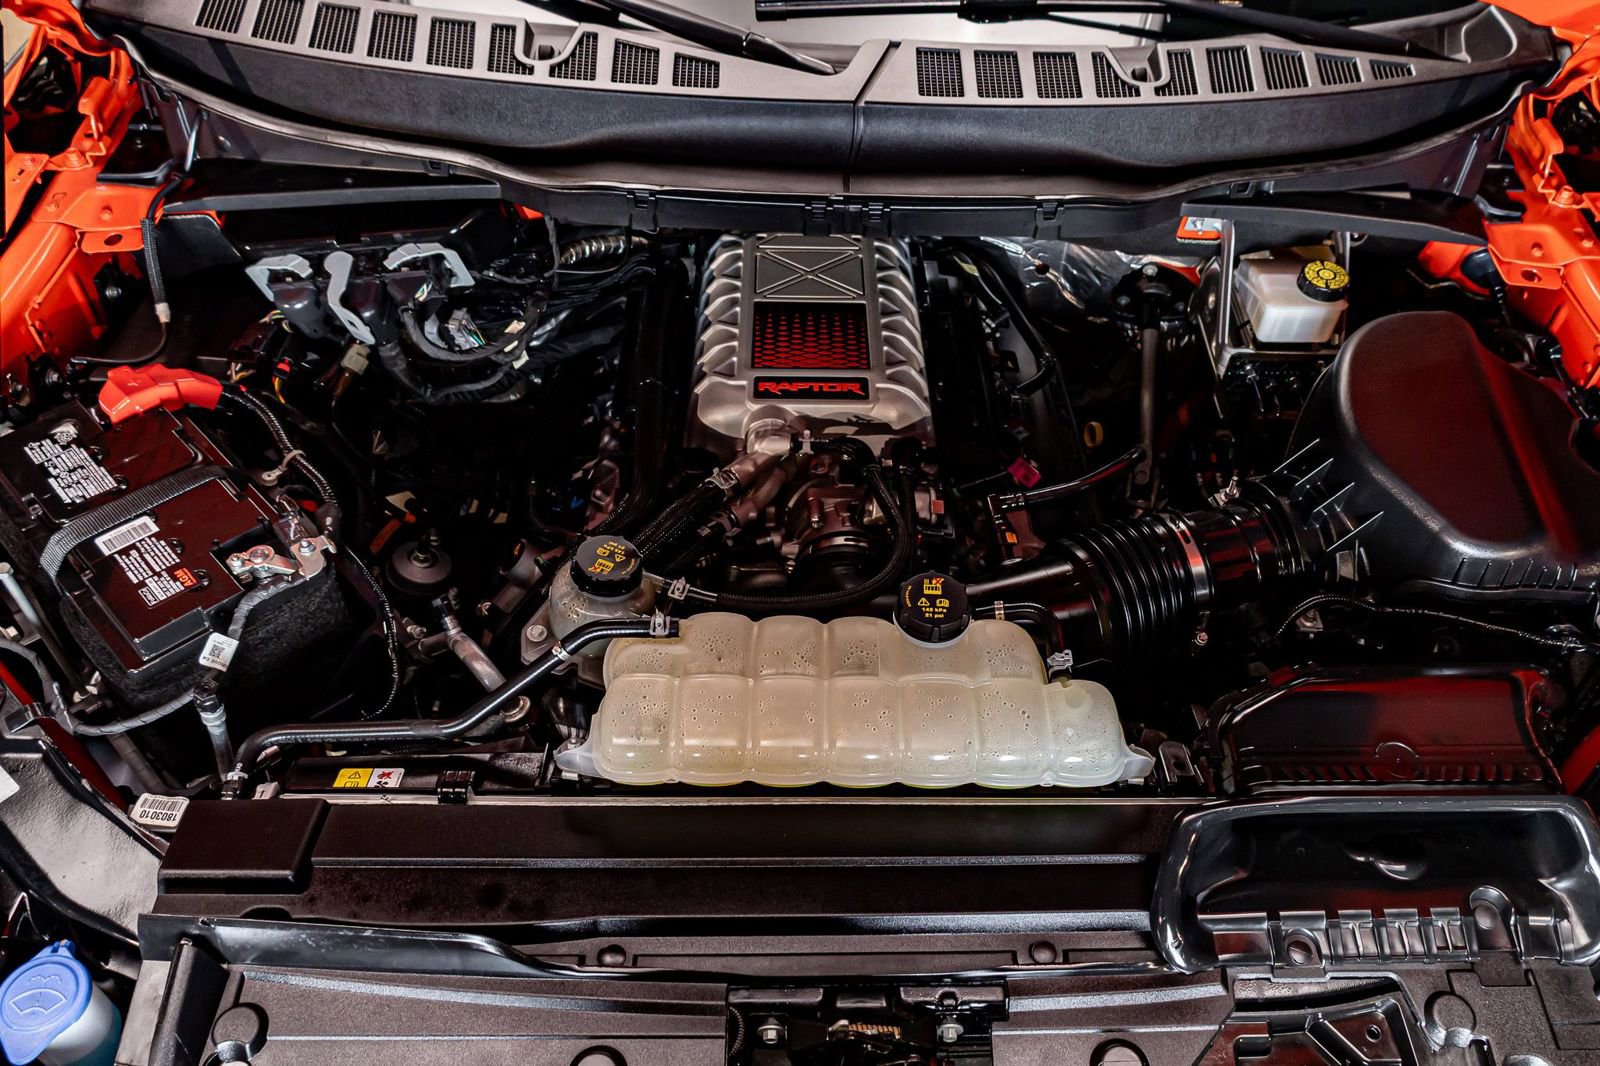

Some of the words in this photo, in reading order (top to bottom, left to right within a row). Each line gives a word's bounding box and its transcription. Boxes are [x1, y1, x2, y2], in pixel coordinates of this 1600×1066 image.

[758, 382, 864, 395] RAPTOR
[174, 569, 192, 587] AGM
[139, 809, 178, 822] 1803010
